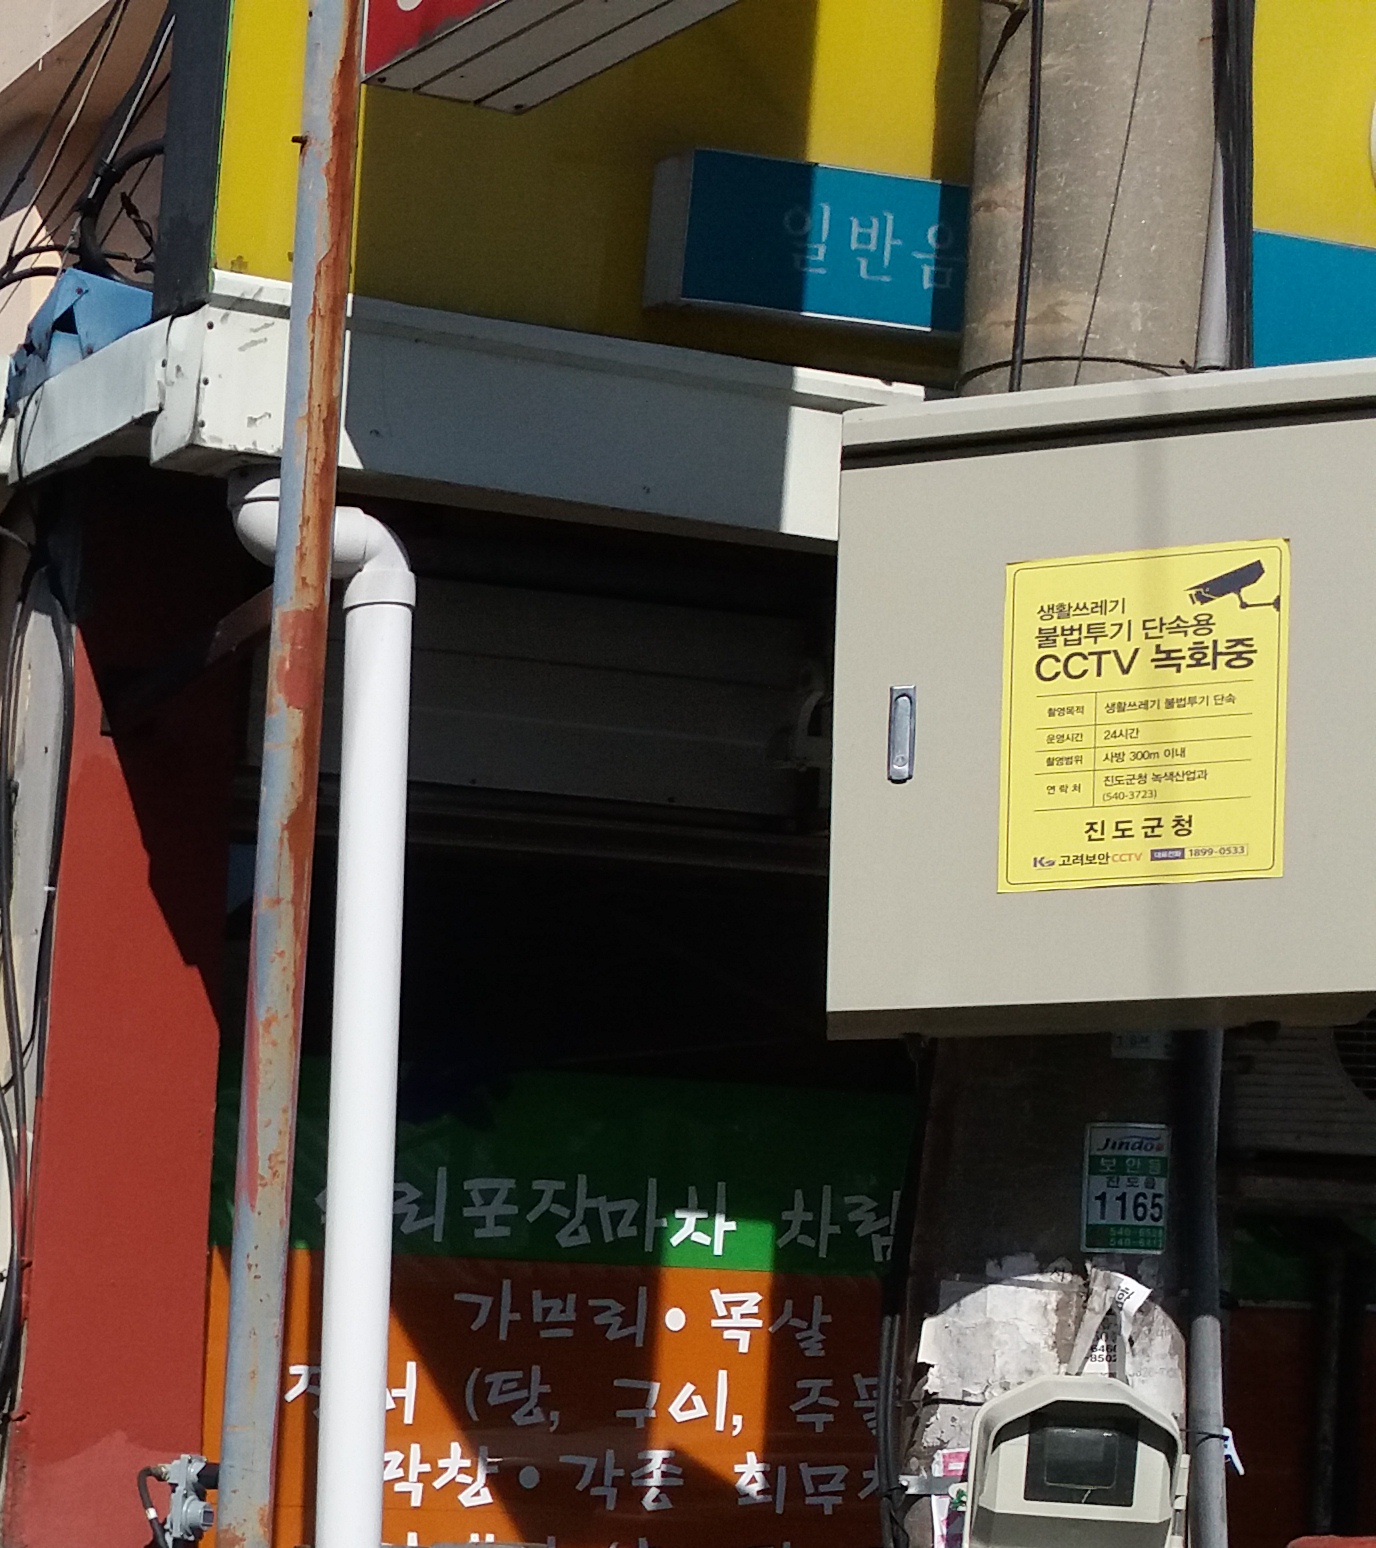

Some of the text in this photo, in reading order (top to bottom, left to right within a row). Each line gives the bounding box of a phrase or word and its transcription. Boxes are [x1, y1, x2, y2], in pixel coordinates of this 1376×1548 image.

[1037, 597, 1126, 621] 생활쓰레기
[1035, 613, 1216, 649] 불법투기 단속용
[1035, 637, 1258, 682] CCTV 녹화중
[1047, 692, 1237, 718] 촬영목적 생활쓰레기 불법투기 단속
[1046, 727, 1140, 744] 운영시간 24시간
[1102, 751, 1126, 764] 사방
[1129, 750, 1160, 762] 300m
[1163, 747, 1187, 759] 이내
[1103, 773, 1149, 787] 진도군청
[1189, 846, 1246, 858] 1899-0533
[1096, 1137, 1155, 1152] Jindo
[1094, 1191, 1165, 1222] 1165
